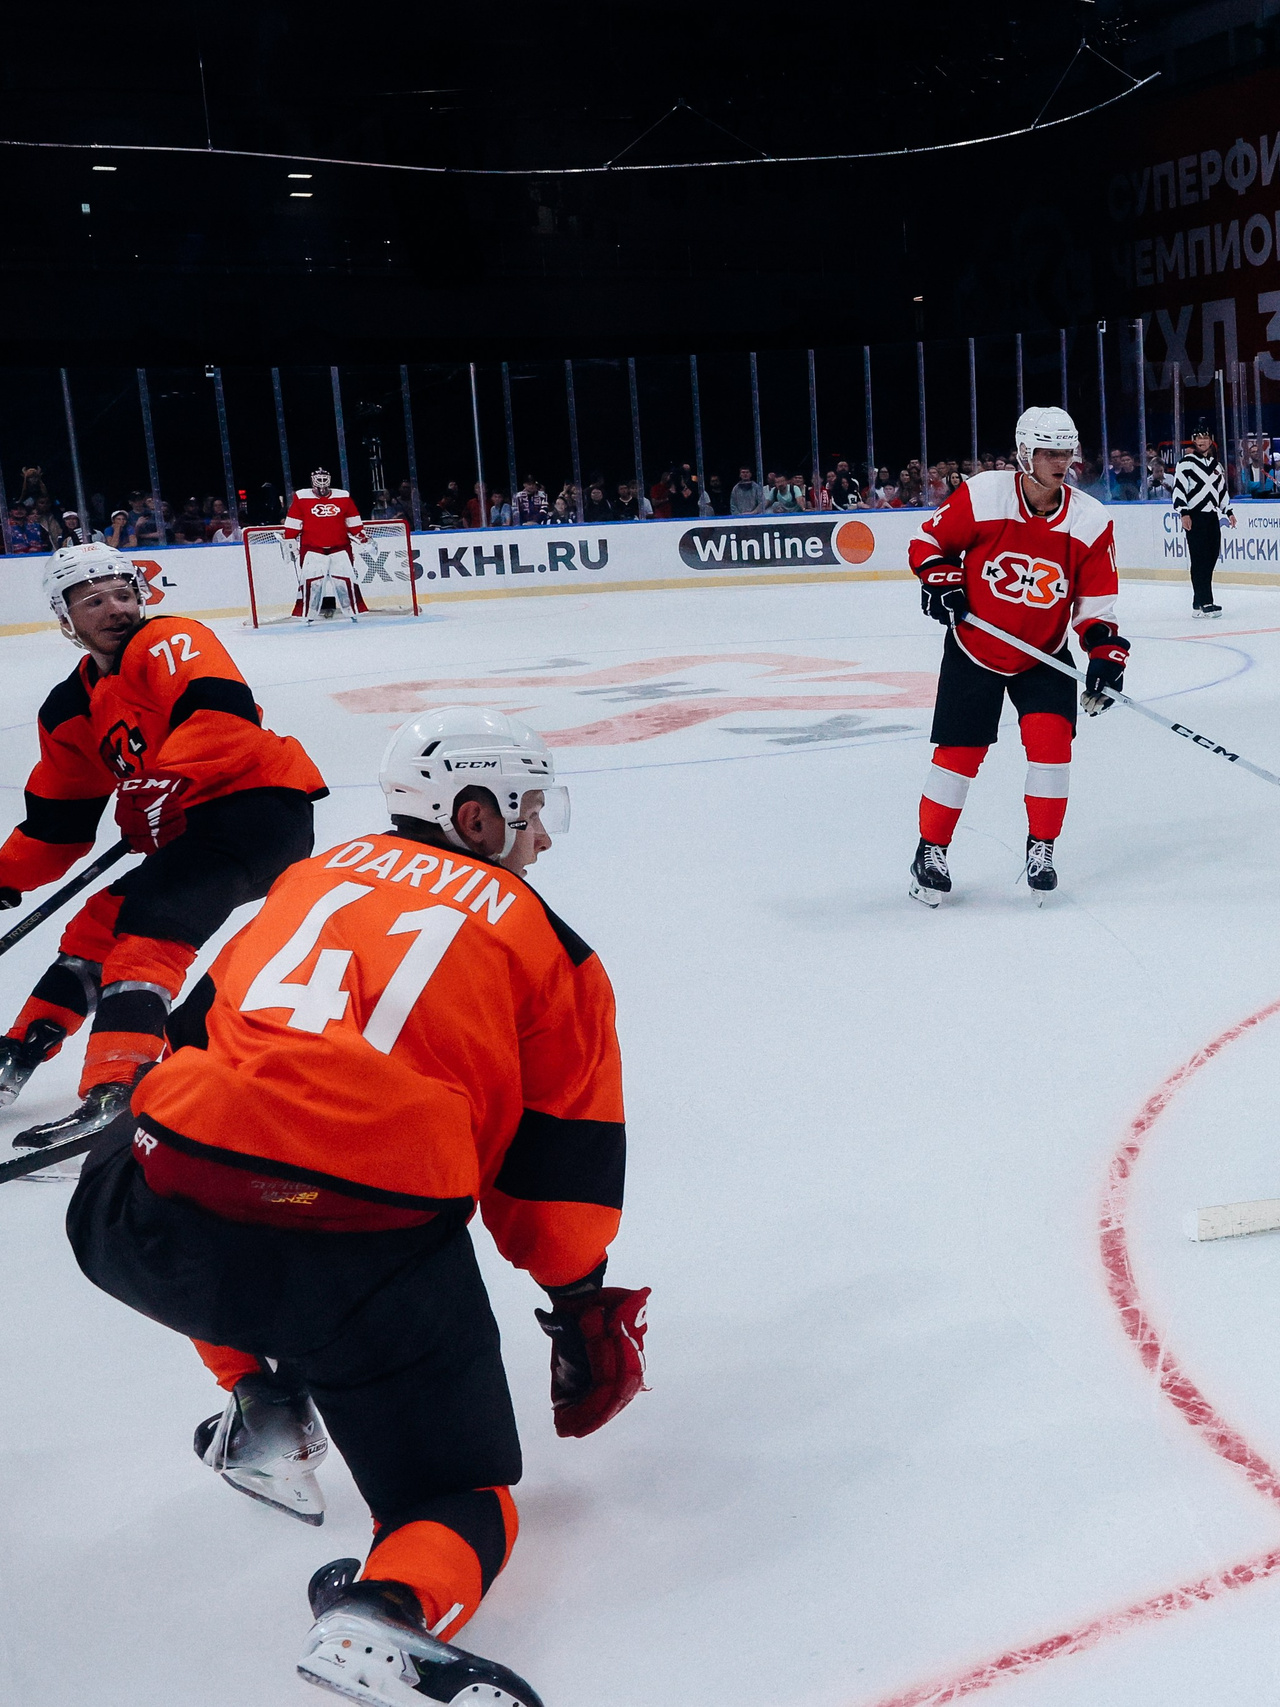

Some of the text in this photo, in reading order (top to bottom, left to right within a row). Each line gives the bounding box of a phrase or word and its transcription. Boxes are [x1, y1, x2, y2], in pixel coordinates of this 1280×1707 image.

[1119, 298, 1239, 391] КХЛ
[353, 539, 609, 584] X3.KHL.RU
[692, 531, 823, 562] Winline
[149, 633, 201, 675] 72
[1171, 723, 1239, 762] CCM
[117, 779, 171, 791] CM
[455, 761, 497, 769] CCM
[324, 841, 517, 926] DARYIN
[239, 881, 468, 1055] 41
